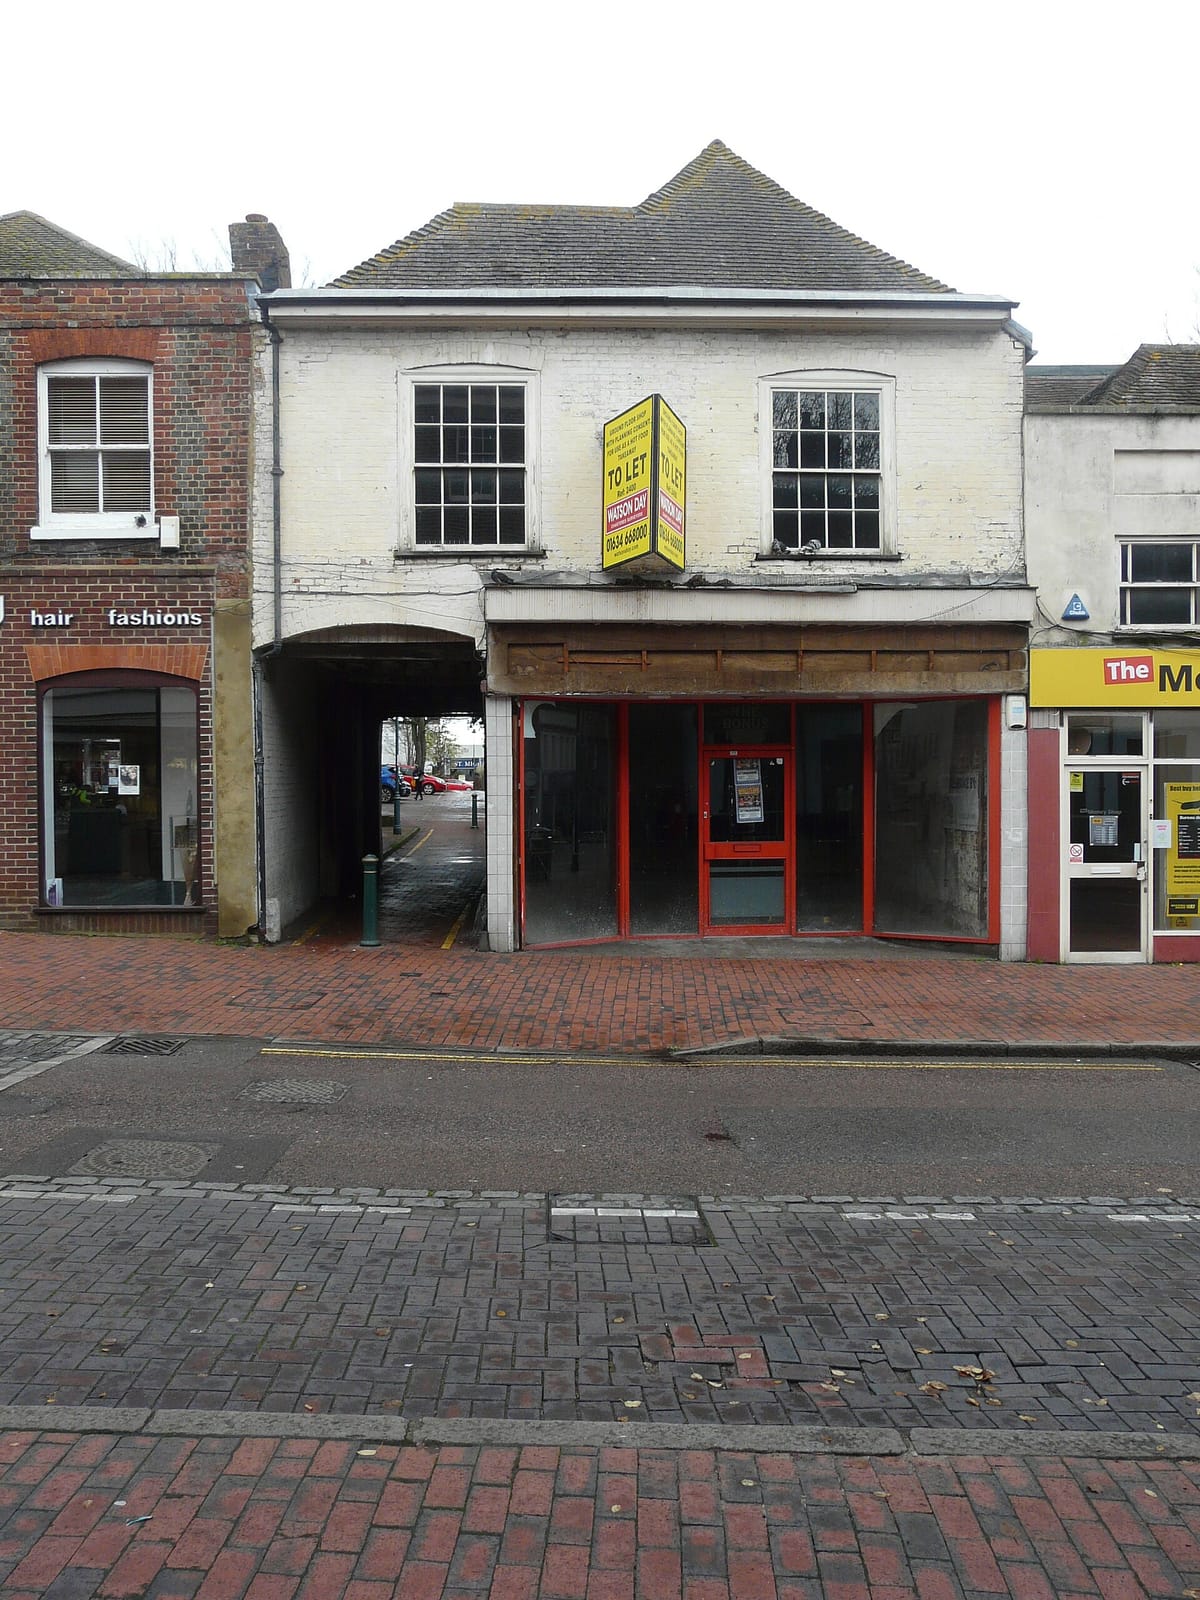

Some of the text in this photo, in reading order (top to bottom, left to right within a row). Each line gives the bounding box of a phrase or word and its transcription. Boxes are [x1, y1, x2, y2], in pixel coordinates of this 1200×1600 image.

[615, 428, 633, 442] PLANNING
[633, 418, 650, 433] CONSENT
[624, 416, 636, 428] FLOOR
[638, 429, 649, 440] FOOD
[617, 446, 637, 461] TAKEAWAY
[608, 452, 647, 490] TO LET
[661, 452, 670, 478] TO
[671, 463, 683, 492] LET
[607, 493, 647, 523] WATSON DAY
[606, 534, 623, 552] 01634
[624, 523, 648, 545] 668000
[31, 609, 202, 626] hair fashions
[1106, 660, 1200, 692] The M
